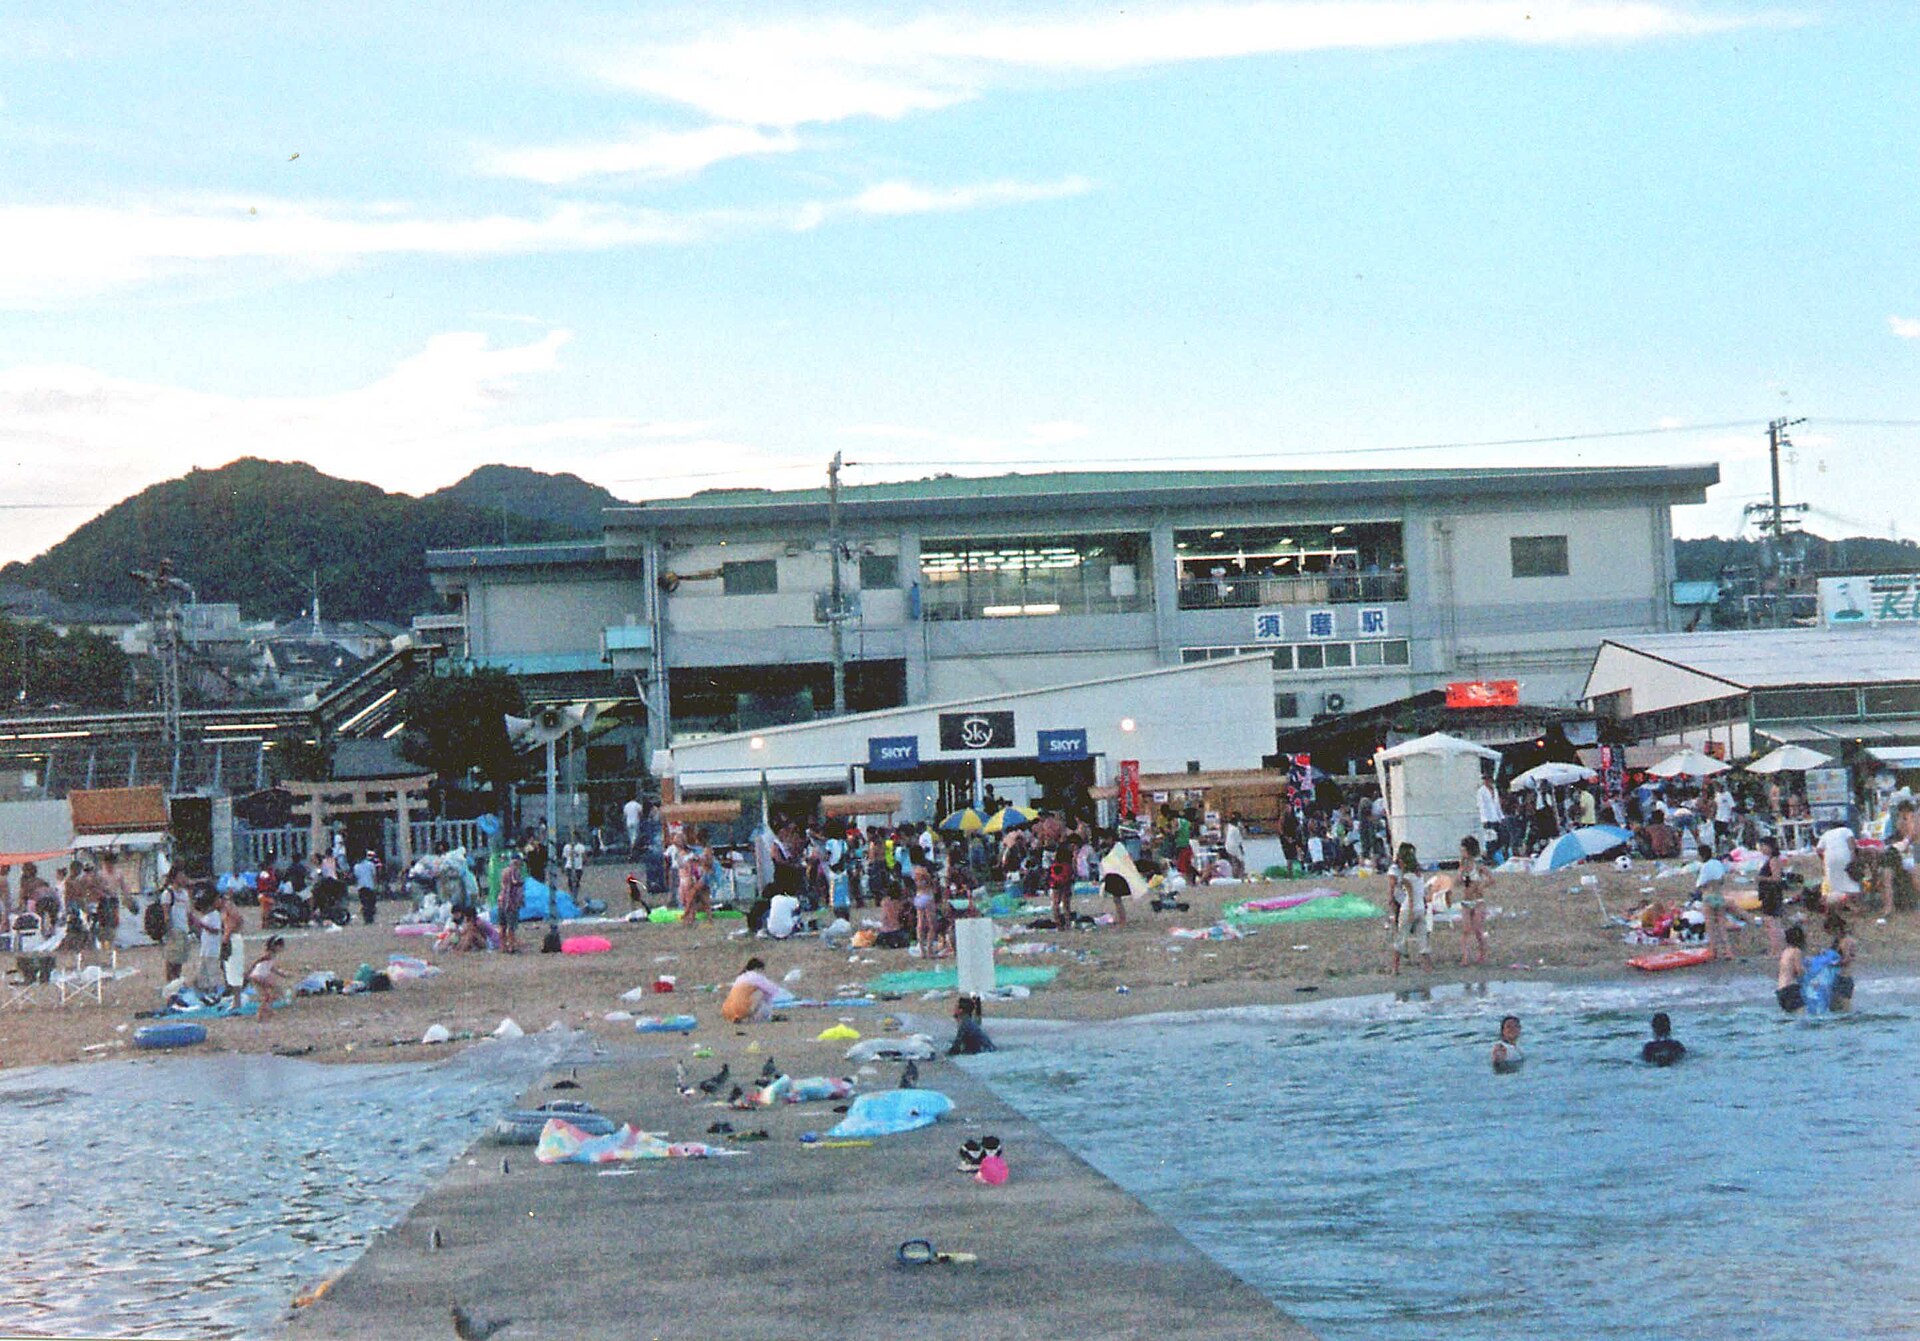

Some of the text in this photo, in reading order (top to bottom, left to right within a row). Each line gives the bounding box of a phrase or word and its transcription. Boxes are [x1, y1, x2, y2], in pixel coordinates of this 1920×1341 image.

[1257, 610, 1385, 638] 須磨駅
[962, 718, 993, 748] Sky
